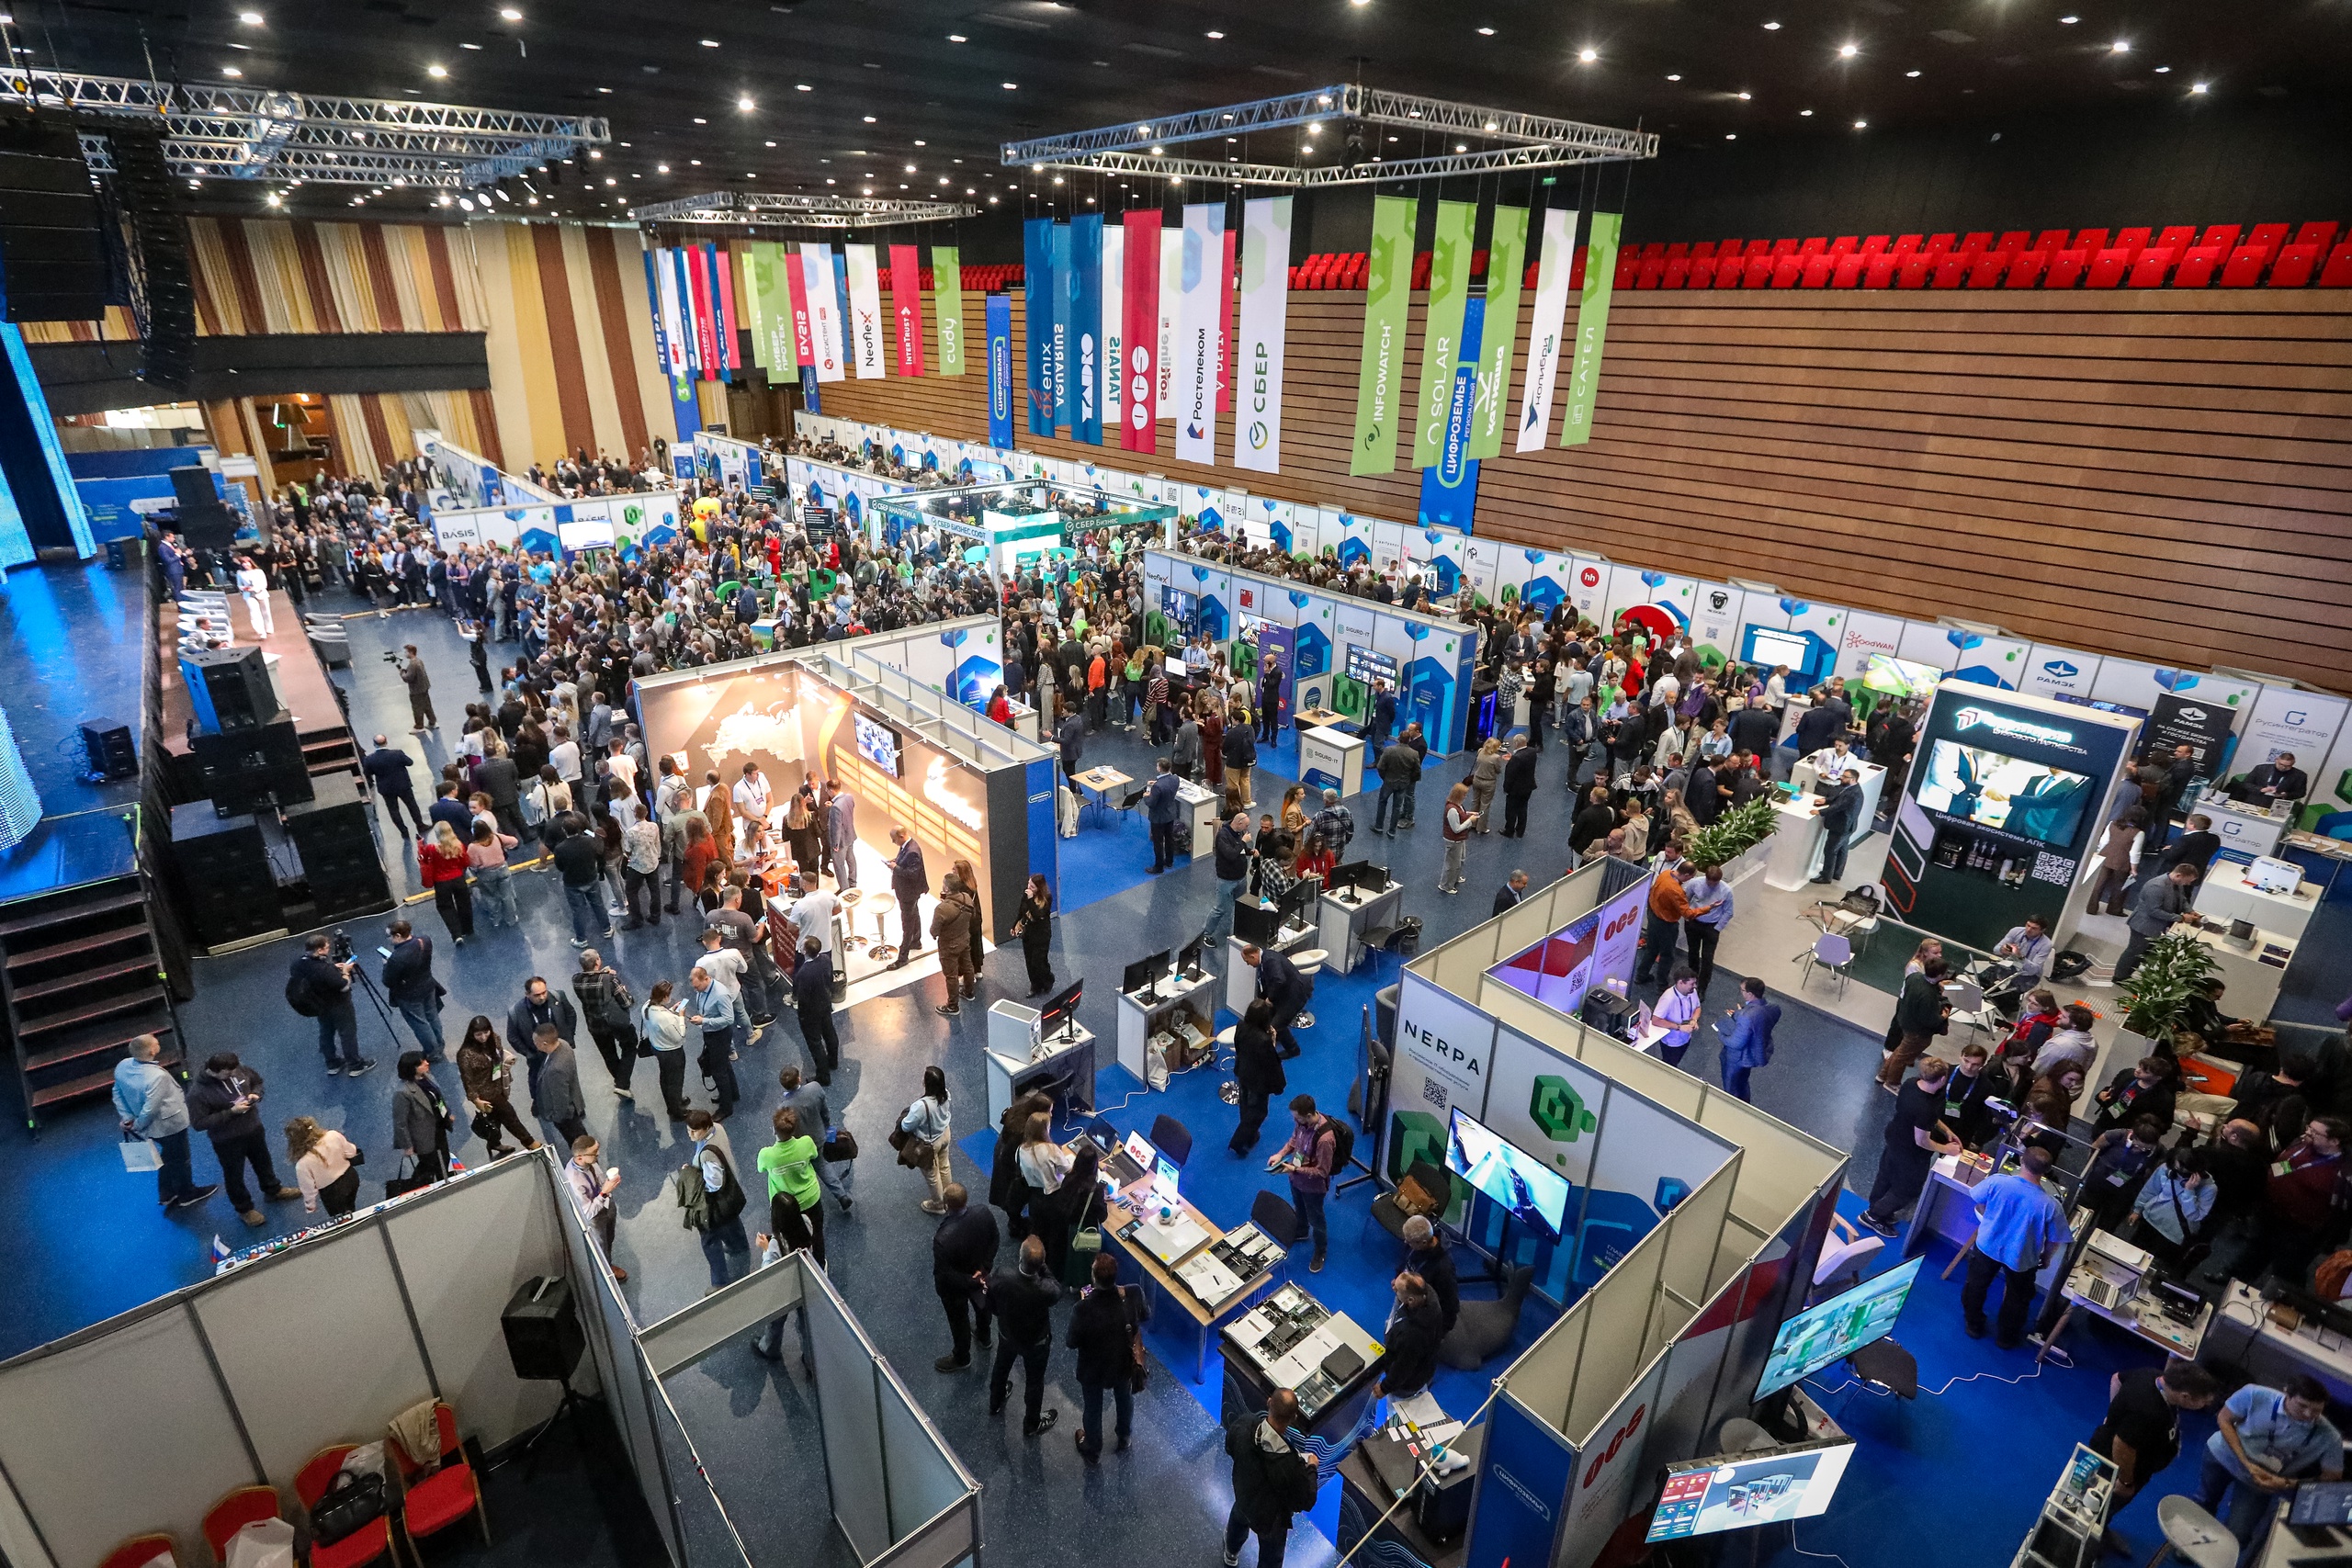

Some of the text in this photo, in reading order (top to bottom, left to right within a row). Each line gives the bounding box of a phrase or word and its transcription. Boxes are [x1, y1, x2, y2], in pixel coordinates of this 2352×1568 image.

[653, 312, 666, 364] NERPA
[771, 331, 783, 371] КИБЕР
[776, 314, 789, 371] ПРОТЕКТ
[857, 308, 874, 367] Neoflex
[943, 318, 957, 364] cudy
[1577, 327, 1595, 397] САТЕЛ
[1043, 343, 1053, 418] axenix
[1080, 333, 1093, 423] YADRO
[1193, 328, 1205, 420] Ростелеком
[1253, 342, 1268, 412] СБЕР
[1374, 325, 1391, 421] INFOWATCH
[1431, 336, 1450, 417] SOLAR
[1535, 337, 1548, 405] колибри
[1446, 376, 1466, 474] ЦИФРОЗЕМЬЕ
[1464, 382, 1476, 438] РЕГИОНАЛЬНЫЙ
[888, 506, 917, 520] АНАЛИТИКА
[937, 519, 987, 539] СБЕР БИЗНЕС СОФТ
[1075, 517, 1118, 529] СБЕР Бизнес
[1147, 571, 1168, 583] Neoflex
[1585, 572, 1595, 581] hh
[2037, 676, 2075, 688] РАМЭК
[2166, 730, 2207, 745] ГОСУДАРСТВА
[2173, 718, 2205, 730] РАМЭК
[1935, 811, 2046, 849] Цифровая экосистема АПК
[1404, 1020, 1480, 1076] NERPA
[1498, 1470, 1544, 1512] ЦИФРОЗЕМЬЕ
